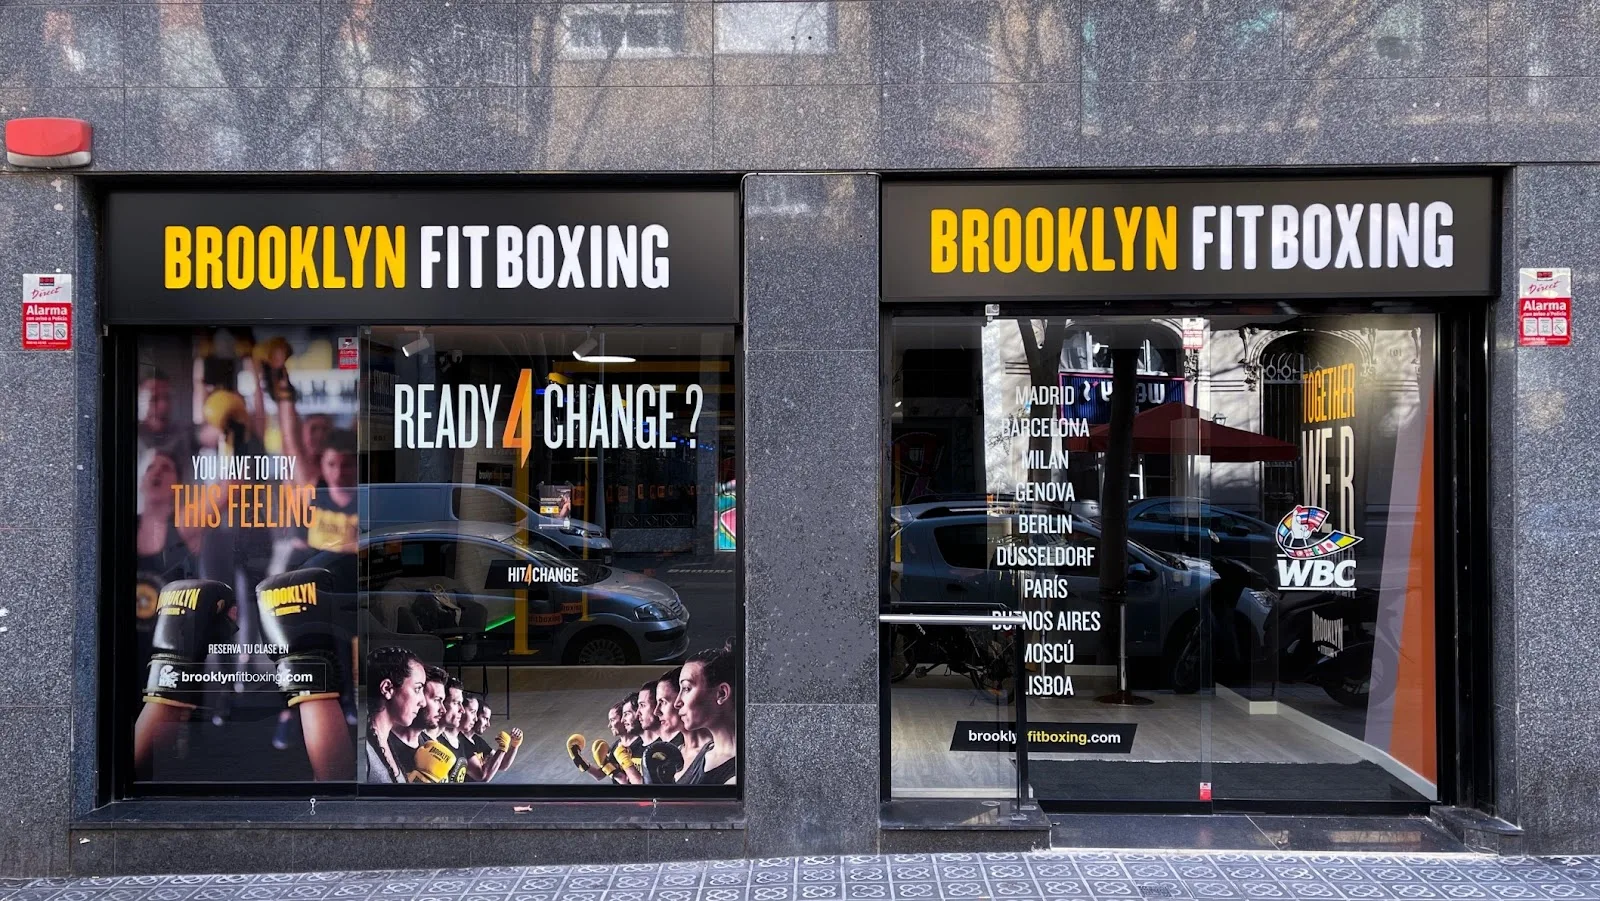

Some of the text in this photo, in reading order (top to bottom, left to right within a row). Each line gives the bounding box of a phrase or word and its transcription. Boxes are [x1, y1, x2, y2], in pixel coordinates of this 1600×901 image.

[930, 205, 1177, 273] BROOKLYN
[164, 225, 405, 290] BROOKLYN
[26, 304, 68, 315] Alarma
[1523, 300, 1567, 311] Alarma
[1015, 385, 1074, 405] MADRID
[1302, 363, 1355, 424] TOGETHER
[394, 383, 501, 448] READY
[543, 383, 677, 449] CHANGE
[1001, 417, 1090, 437] BARCELONA
[192, 455, 296, 481] YOU HAVE TO TRY
[1021, 449, 1069, 469] MILAN
[1015, 482, 1075, 502] GENOVA
[171, 484, 316, 528] THIS FEELING
[1018, 514, 1073, 534] BERLIN
[996, 543, 1096, 567] DÜSSELDORF
[1277, 559, 1357, 587] WBC
[1024, 575, 1068, 598] PARÍS
[1057, 611, 1101, 631] AIRES
[1312, 611, 1343, 652] BROOKLYN
[208, 643, 289, 654] RESERVA TU CLASE EN
[181, 671, 313, 684] brooklynfitboxing.com
[1025, 675, 1074, 696] ISBOA
[968, 729, 1121, 745] brooklyfitboxing.com
